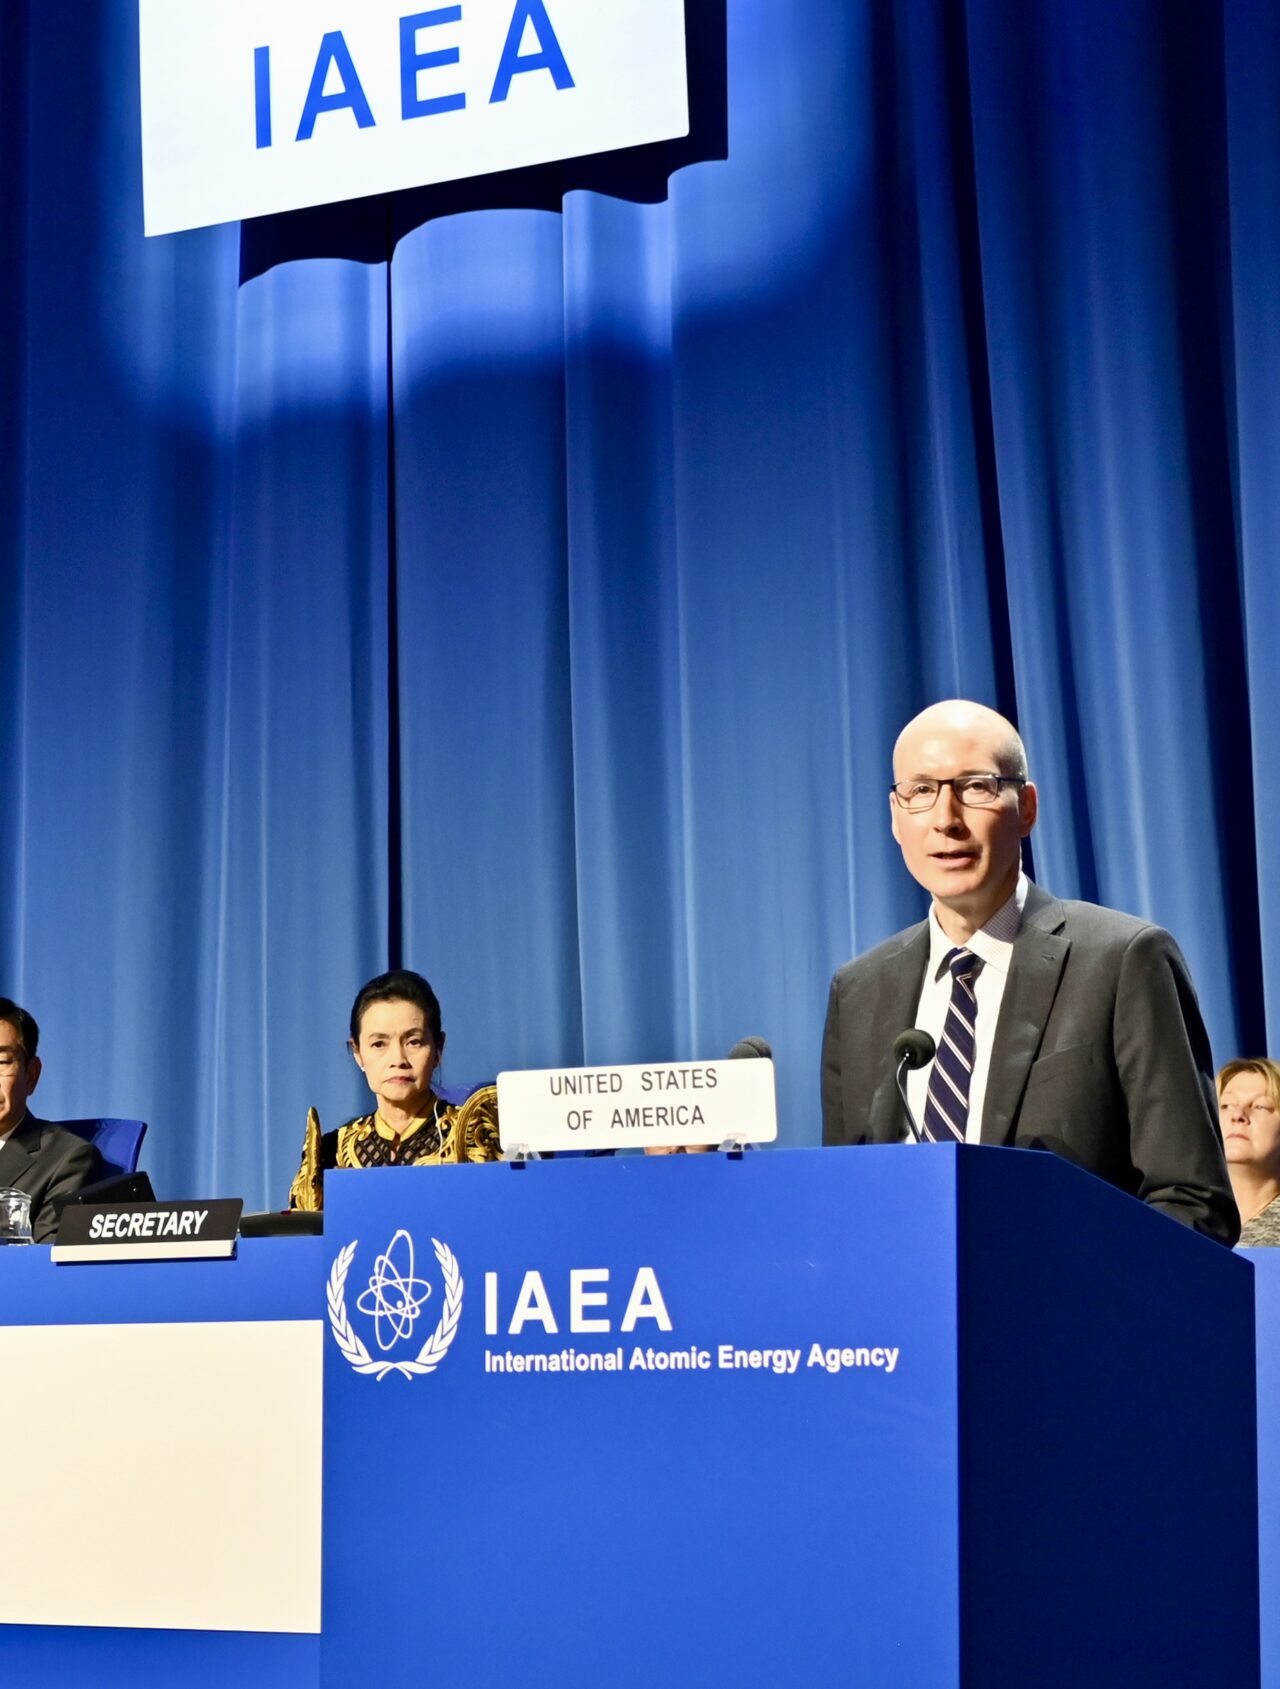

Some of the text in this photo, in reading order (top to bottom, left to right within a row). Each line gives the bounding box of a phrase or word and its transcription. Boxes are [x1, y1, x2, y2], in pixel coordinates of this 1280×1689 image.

[254, 0, 575, 149] IAEA
[550, 1067, 718, 1095] UNITED STATES
[567, 1105, 704, 1130] OF AMERICA
[89, 1210, 208, 1238] SECRETARY
[485, 1267, 672, 1335] IAEA
[485, 1344, 899, 1373] International Atomic Energy Agency
